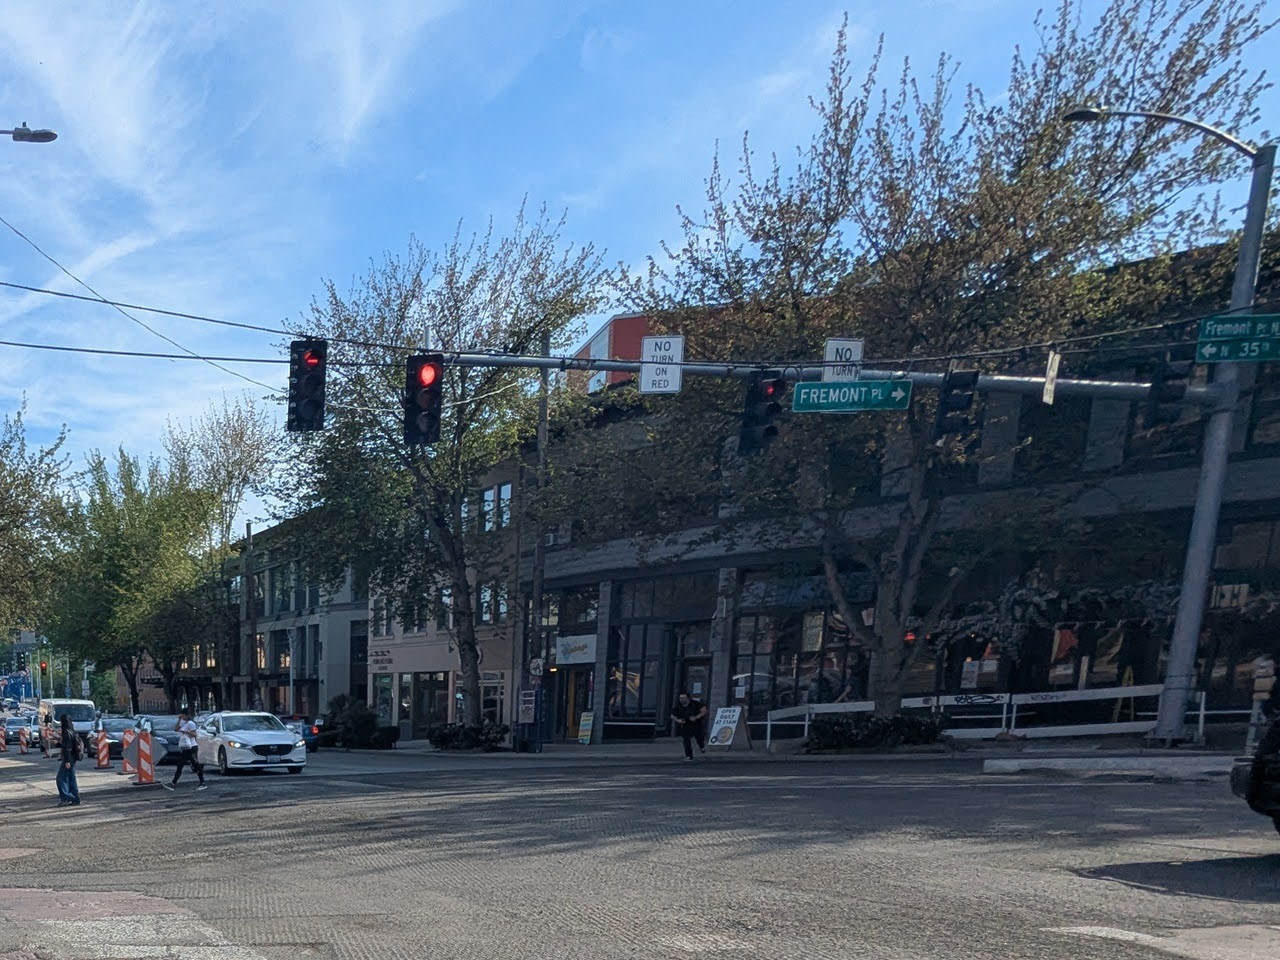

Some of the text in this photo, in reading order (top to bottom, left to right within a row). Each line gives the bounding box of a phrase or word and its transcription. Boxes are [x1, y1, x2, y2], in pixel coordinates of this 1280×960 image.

[1205, 320, 1252, 335] Fremont
[654, 341, 672, 352] NO
[650, 354, 674, 362] TURN
[834, 347, 853, 361] NO
[655, 367, 667, 376] ON
[831, 366, 853, 376] TURN
[651, 379, 669, 388] RED
[800, 387, 884, 404] FREMONT PL
